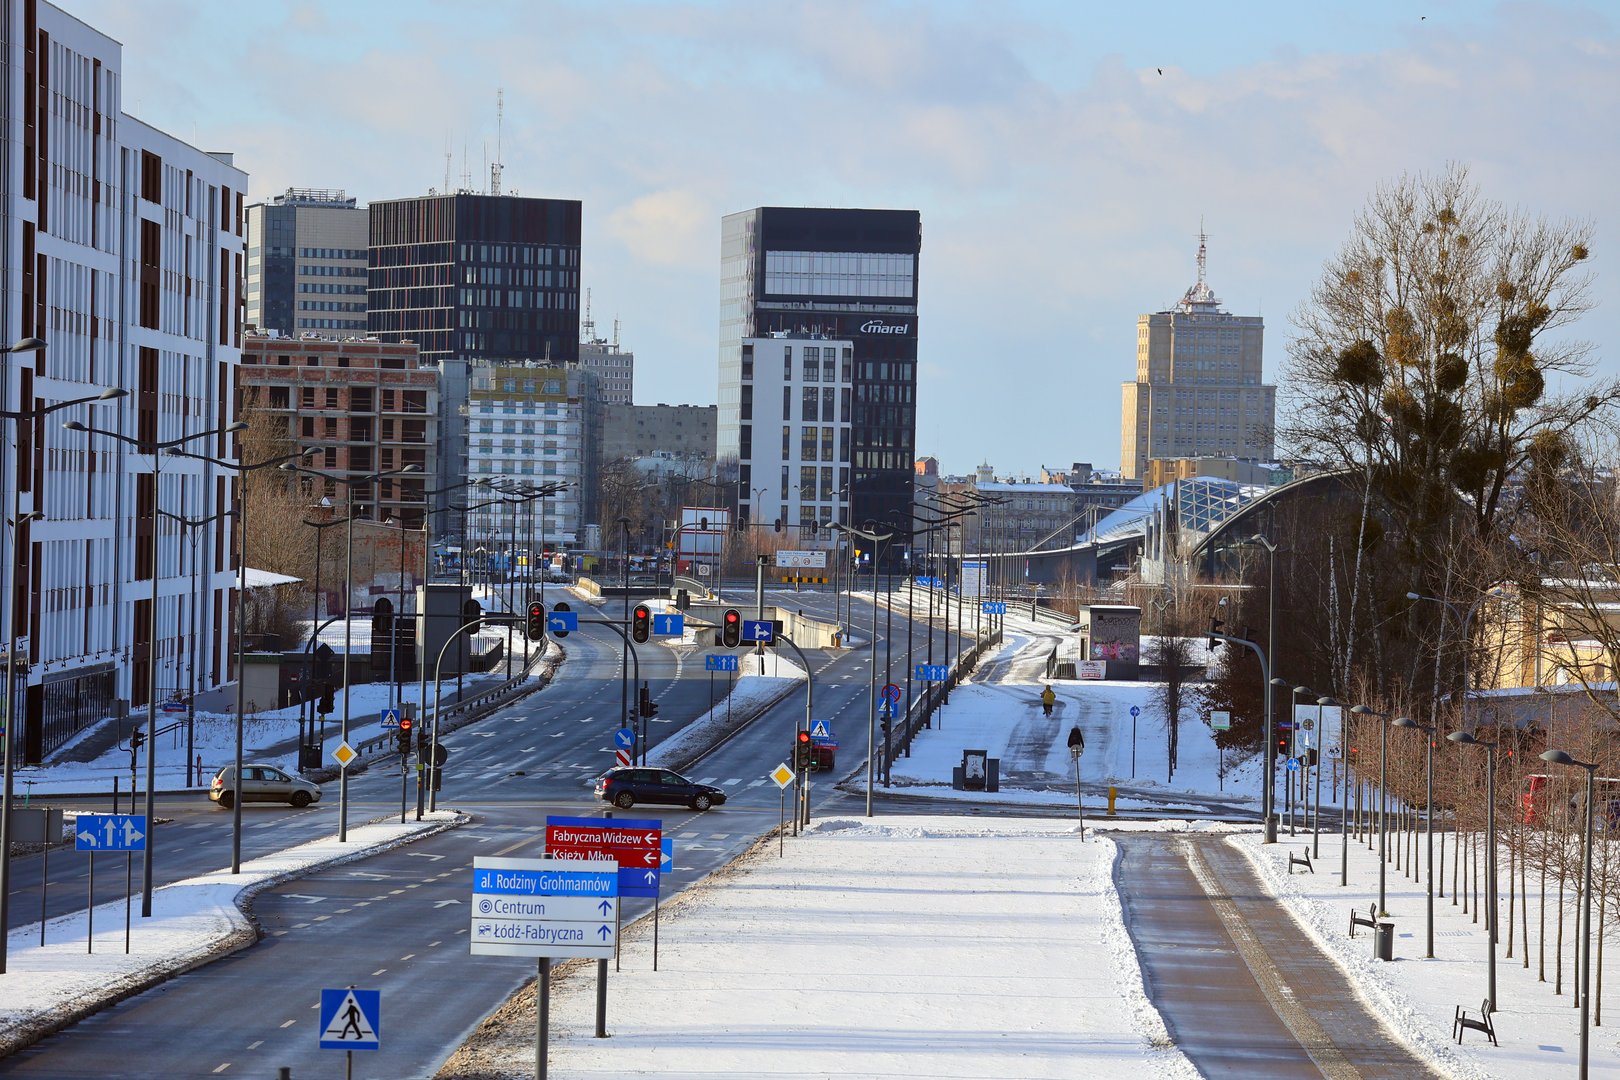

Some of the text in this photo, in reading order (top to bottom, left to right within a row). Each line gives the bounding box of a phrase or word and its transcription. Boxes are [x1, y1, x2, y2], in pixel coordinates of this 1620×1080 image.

[866, 322, 909, 334] marel
[553, 830, 642, 845] Fabryczna Widzew
[480, 873, 611, 894] al. Rodziny Grohmannów
[494, 899, 545, 915] Centrum
[494, 923, 584, 944] Łódź-Fabryczna
